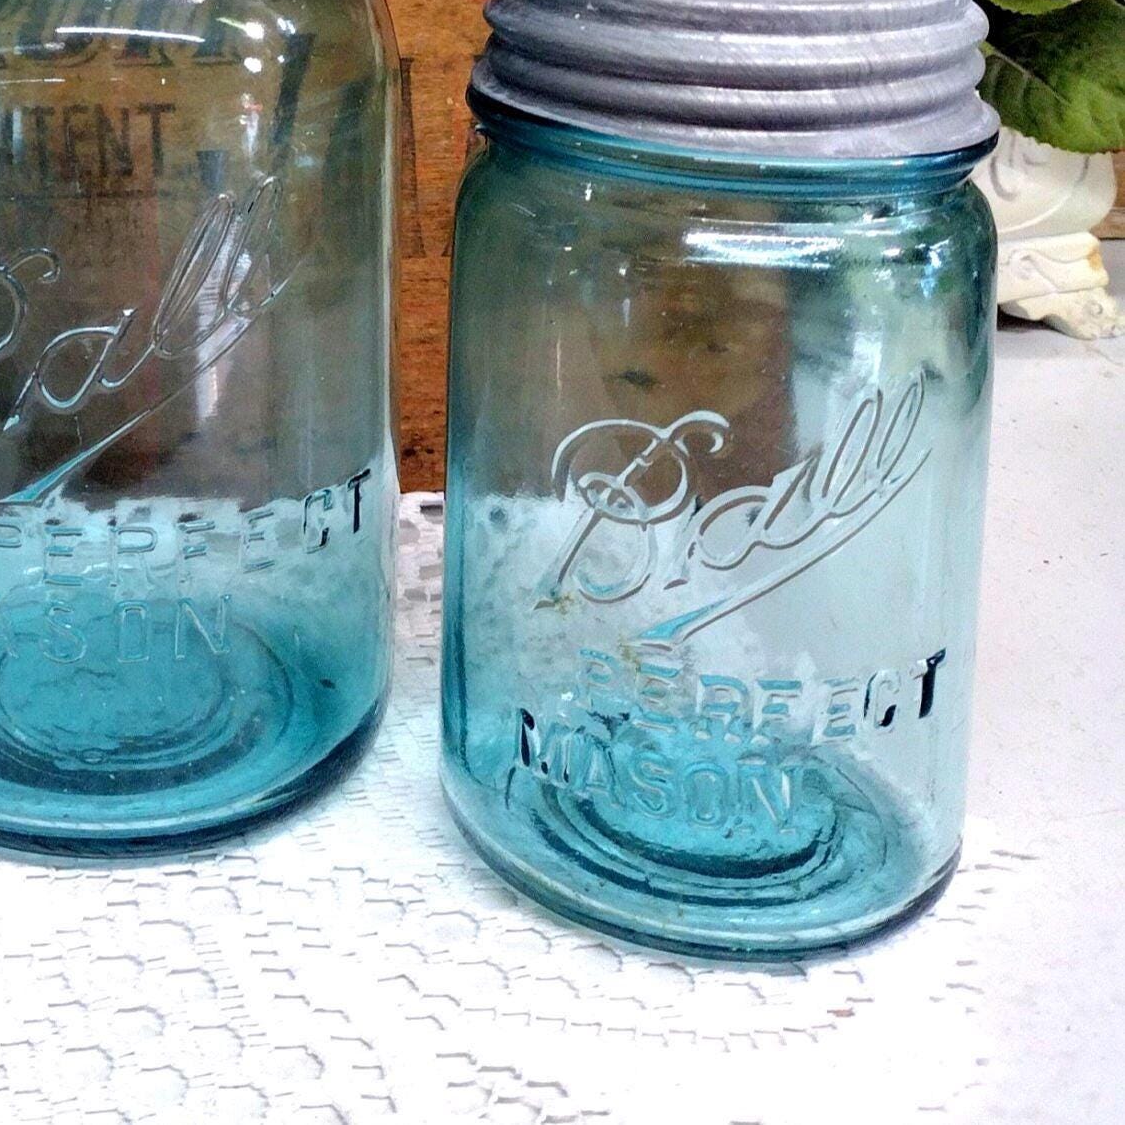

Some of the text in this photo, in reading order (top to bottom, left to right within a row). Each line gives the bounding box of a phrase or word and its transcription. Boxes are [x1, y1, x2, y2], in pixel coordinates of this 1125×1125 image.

[532, 368, 933, 652] Ball
[575, 646, 948, 745] PERFECT
[515, 706, 809, 835] MASON
